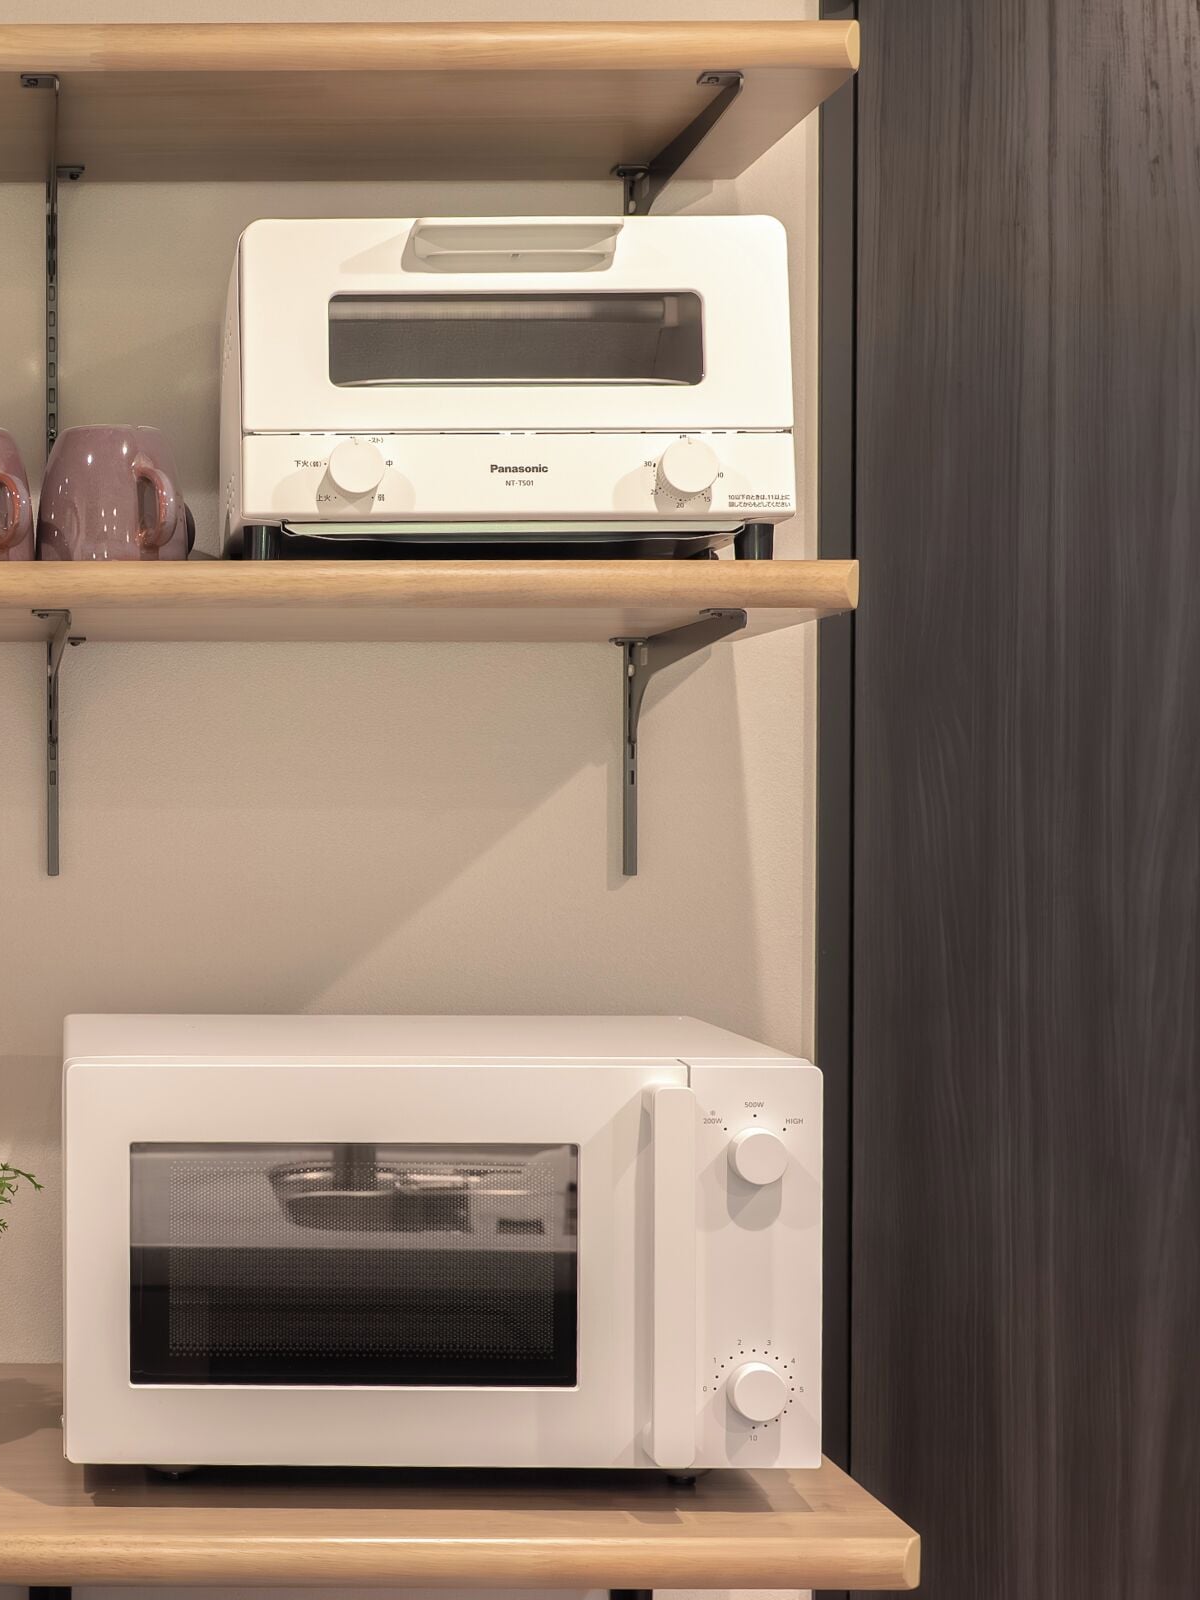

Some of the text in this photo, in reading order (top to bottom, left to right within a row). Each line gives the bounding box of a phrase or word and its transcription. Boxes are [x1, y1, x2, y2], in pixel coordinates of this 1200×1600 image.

[490, 464, 549, 473] Panasonic
[316, 494, 331, 502] 上火
[377, 494, 385, 502] 弱
